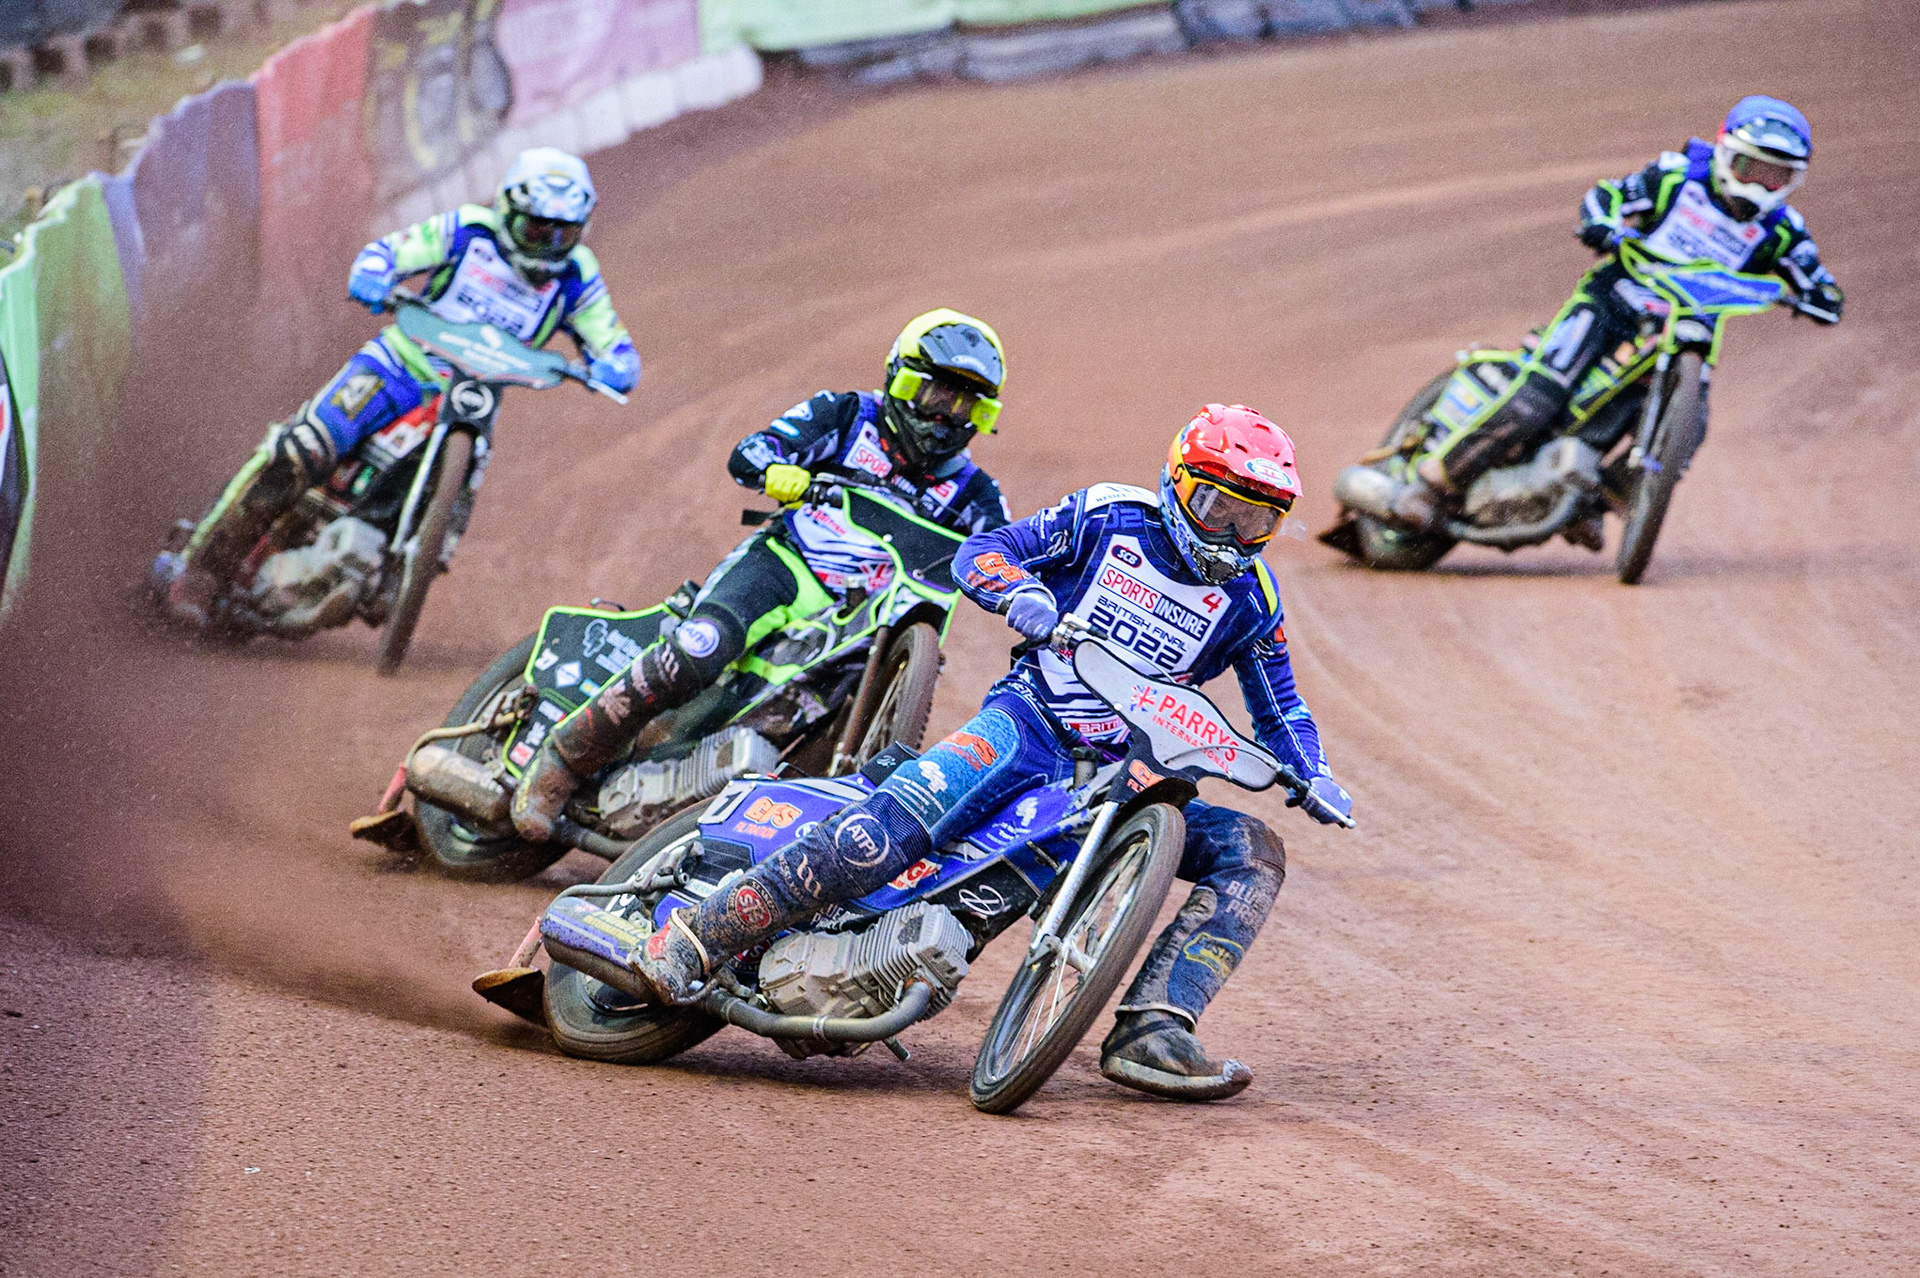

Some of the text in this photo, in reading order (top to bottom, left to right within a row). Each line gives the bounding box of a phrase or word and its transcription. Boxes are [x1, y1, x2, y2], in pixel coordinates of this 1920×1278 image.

[1097, 595, 1187, 652] BRITISH FINAL
[1202, 592, 1223, 613] 4
[1086, 605, 1184, 671] 2022
[1158, 694, 1240, 762] PARRYS
[712, 791, 743, 817] 1
[846, 824, 879, 858] ATPI
